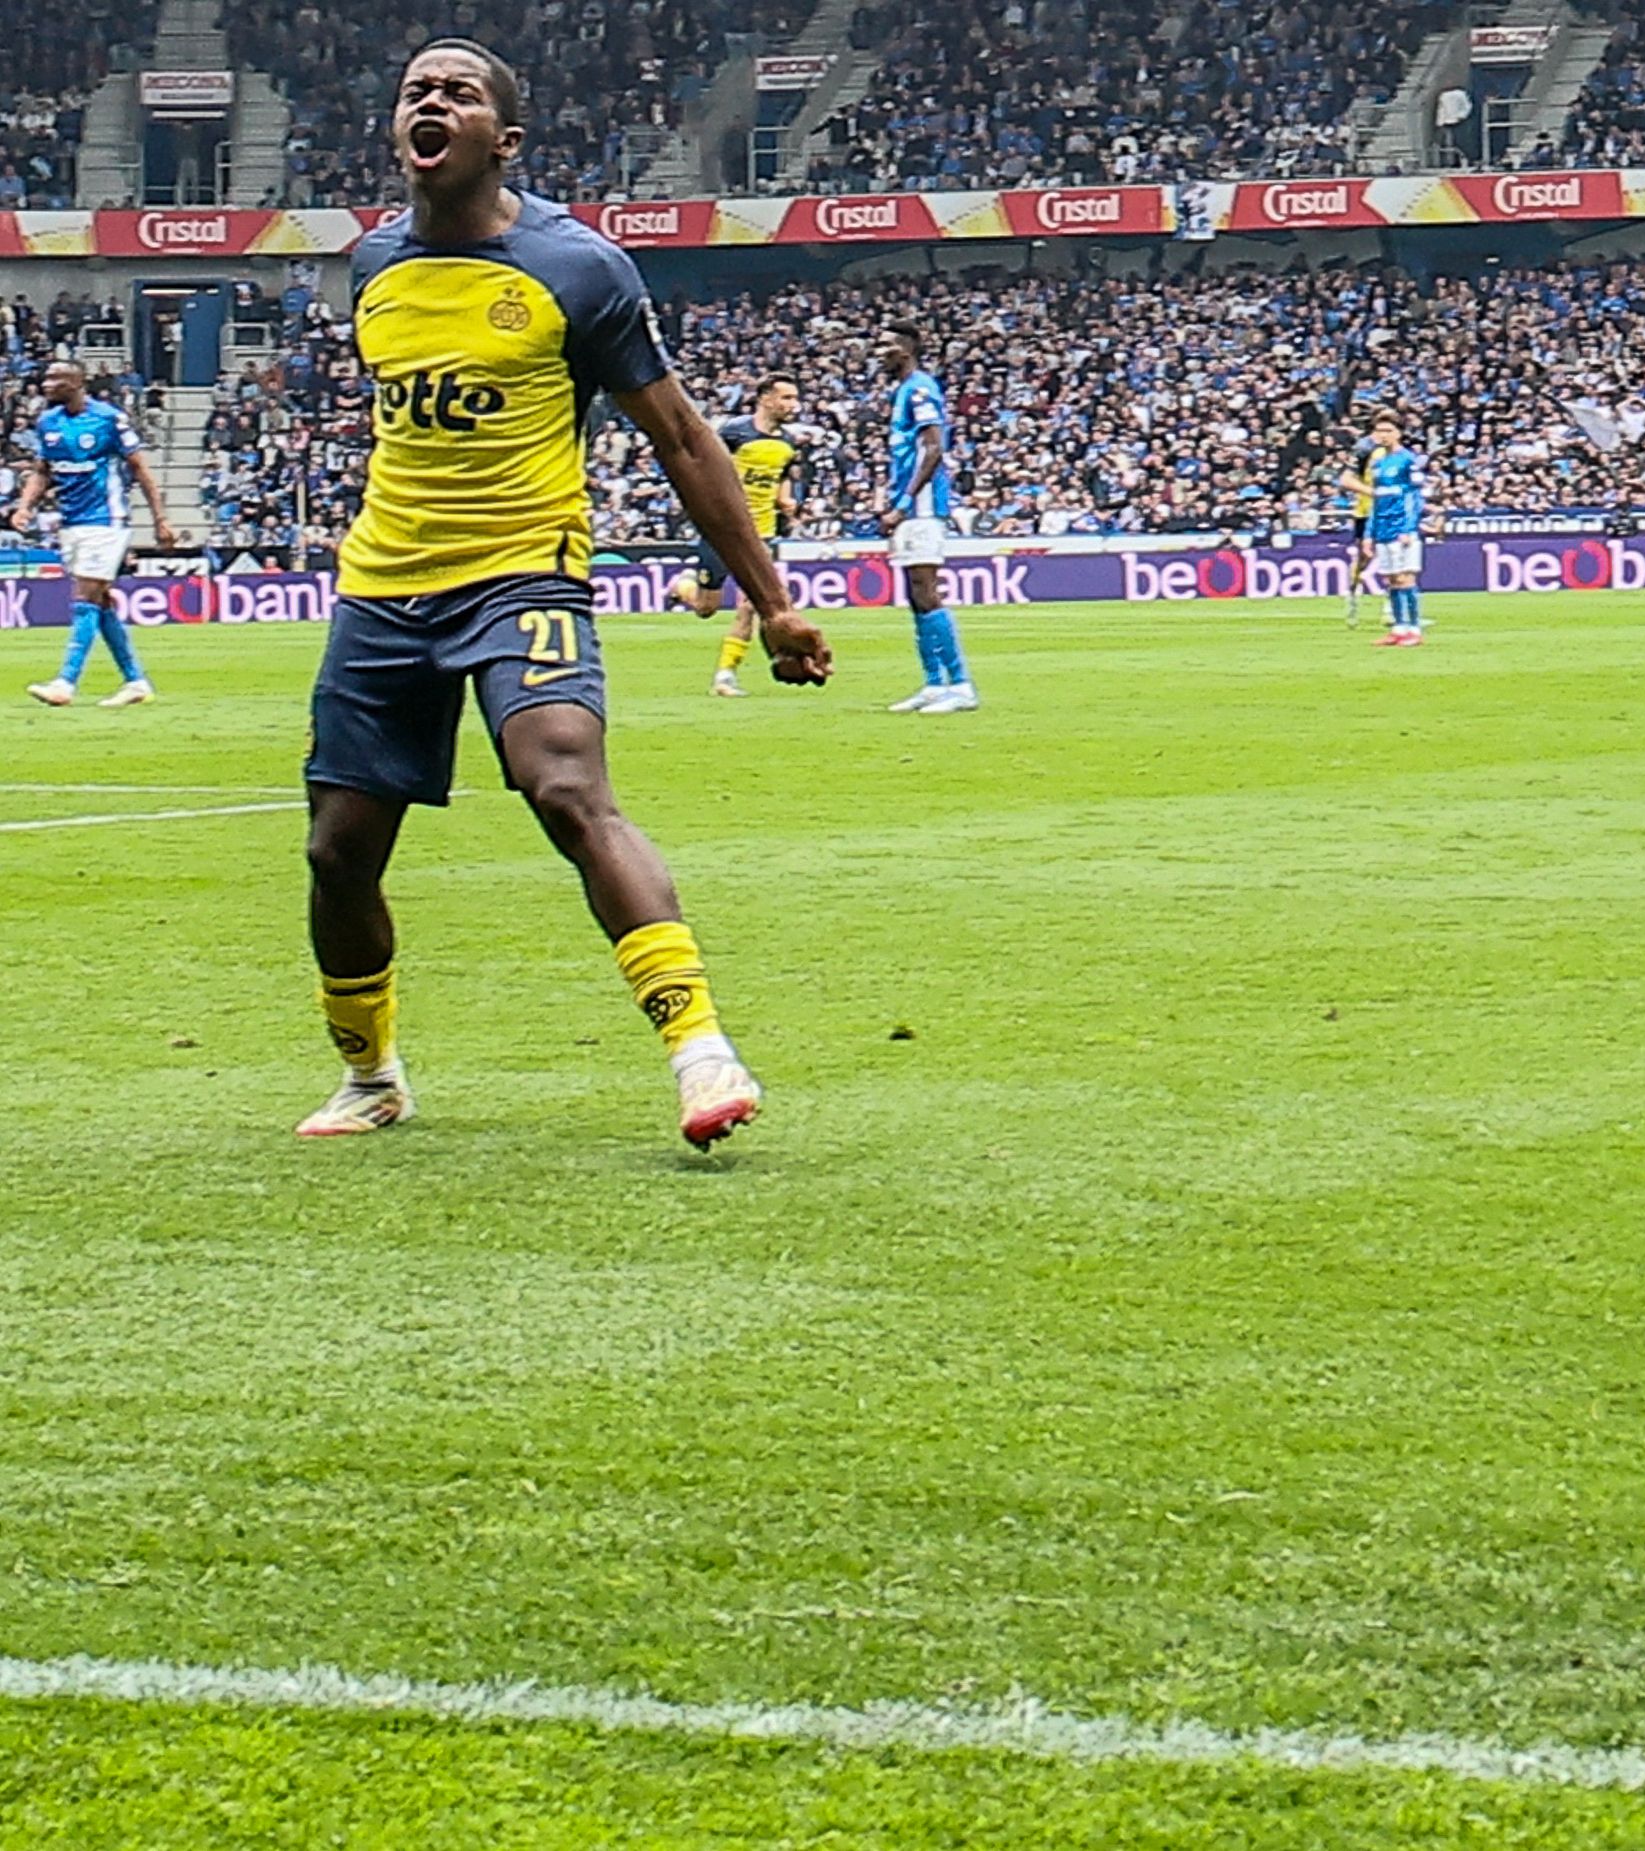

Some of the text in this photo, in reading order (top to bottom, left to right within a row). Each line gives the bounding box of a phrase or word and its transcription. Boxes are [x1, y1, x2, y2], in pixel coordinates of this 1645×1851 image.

[1036, 192, 1120, 228] Cristal
[1262, 185, 1348, 222] Cristal
[1493, 176, 1581, 213] Cristal
[138, 212, 226, 248] Cristal
[599, 205, 679, 241] Cristal
[815, 199, 898, 236] Cristal
[519, 610, 578, 662] 27
